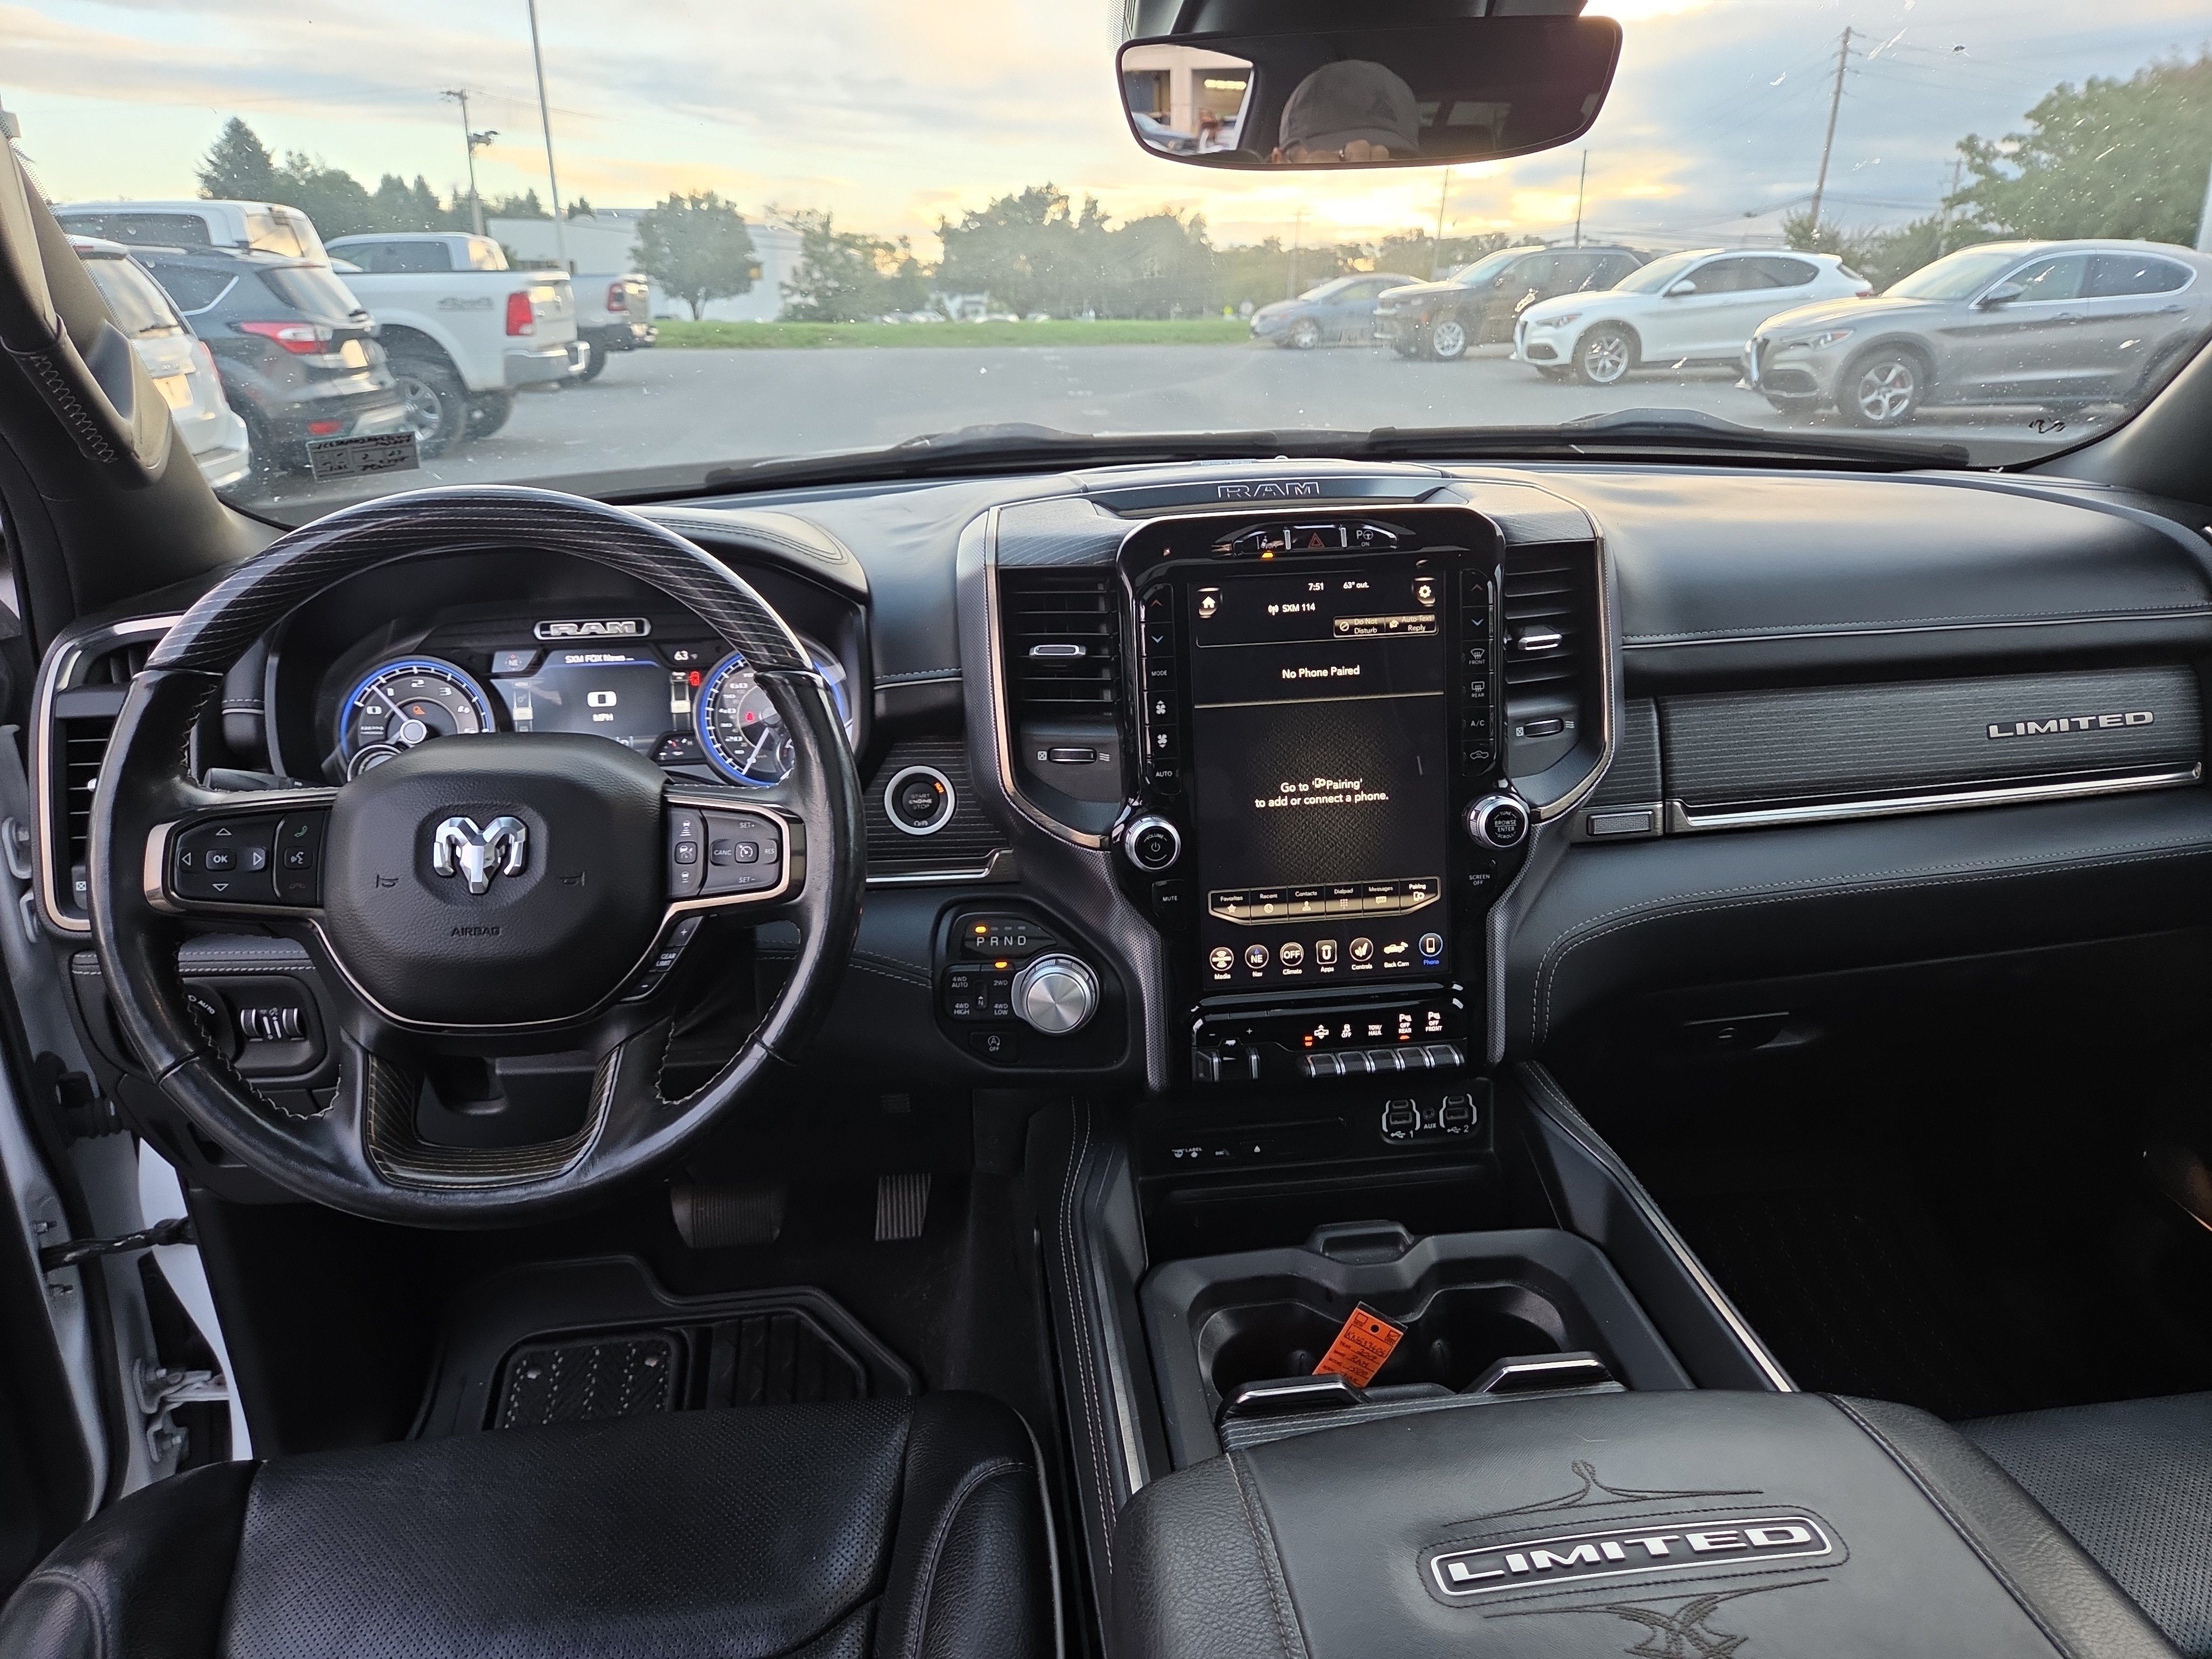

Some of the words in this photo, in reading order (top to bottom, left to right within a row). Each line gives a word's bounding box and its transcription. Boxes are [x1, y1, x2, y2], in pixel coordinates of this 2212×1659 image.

[1217, 481, 1320, 498] RAM
[1307, 582, 1324, 591] 7:51
[1282, 604, 1300, 613] SXM
[1302, 602, 1315, 611] 114
[549, 621, 636, 636] RAM
[1407, 624, 1426, 632] Reply
[564, 654, 584, 664] SXM
[585, 654, 603, 662] FOX
[674, 651, 689, 660] 63
[1282, 669, 1297, 679] No
[1298, 667, 1328, 678] Phone
[1330, 664, 1360, 676] Paired
[411, 679, 425, 687] 2
[439, 687, 452, 696] 3
[587, 691, 617, 707] 0
[366, 706, 382, 715] 0
[1989, 711, 2153, 738] LIMITED
[1280, 782, 1296, 793] Go
[1298, 782, 1309, 792] to
[1255, 799, 1266, 808] to
[1268, 796, 1288, 807] add
[1290, 797, 1301, 806] or
[1303, 793, 1343, 805] connect
[1345, 794, 1352, 802] a
[1354, 790, 1389, 803] phone.
[213, 854, 228, 863] OK
[1334, 887, 1354, 895] Dialpad
[451, 927, 501, 937] AIRBAG
[976, 936, 985, 947] P
[990, 936, 999, 946] R
[1004, 936, 1013, 946] N
[1018, 935, 1026, 946] D
[1251, 954, 1263, 963] NE
[1283, 950, 1301, 960] OFF
[1320, 965, 1334, 973] Apps
[197, 1000, 215, 1014] AUTO
[1463, 1124, 1469, 1133] 2
[1447, 1526, 1812, 1583] LIMITED
